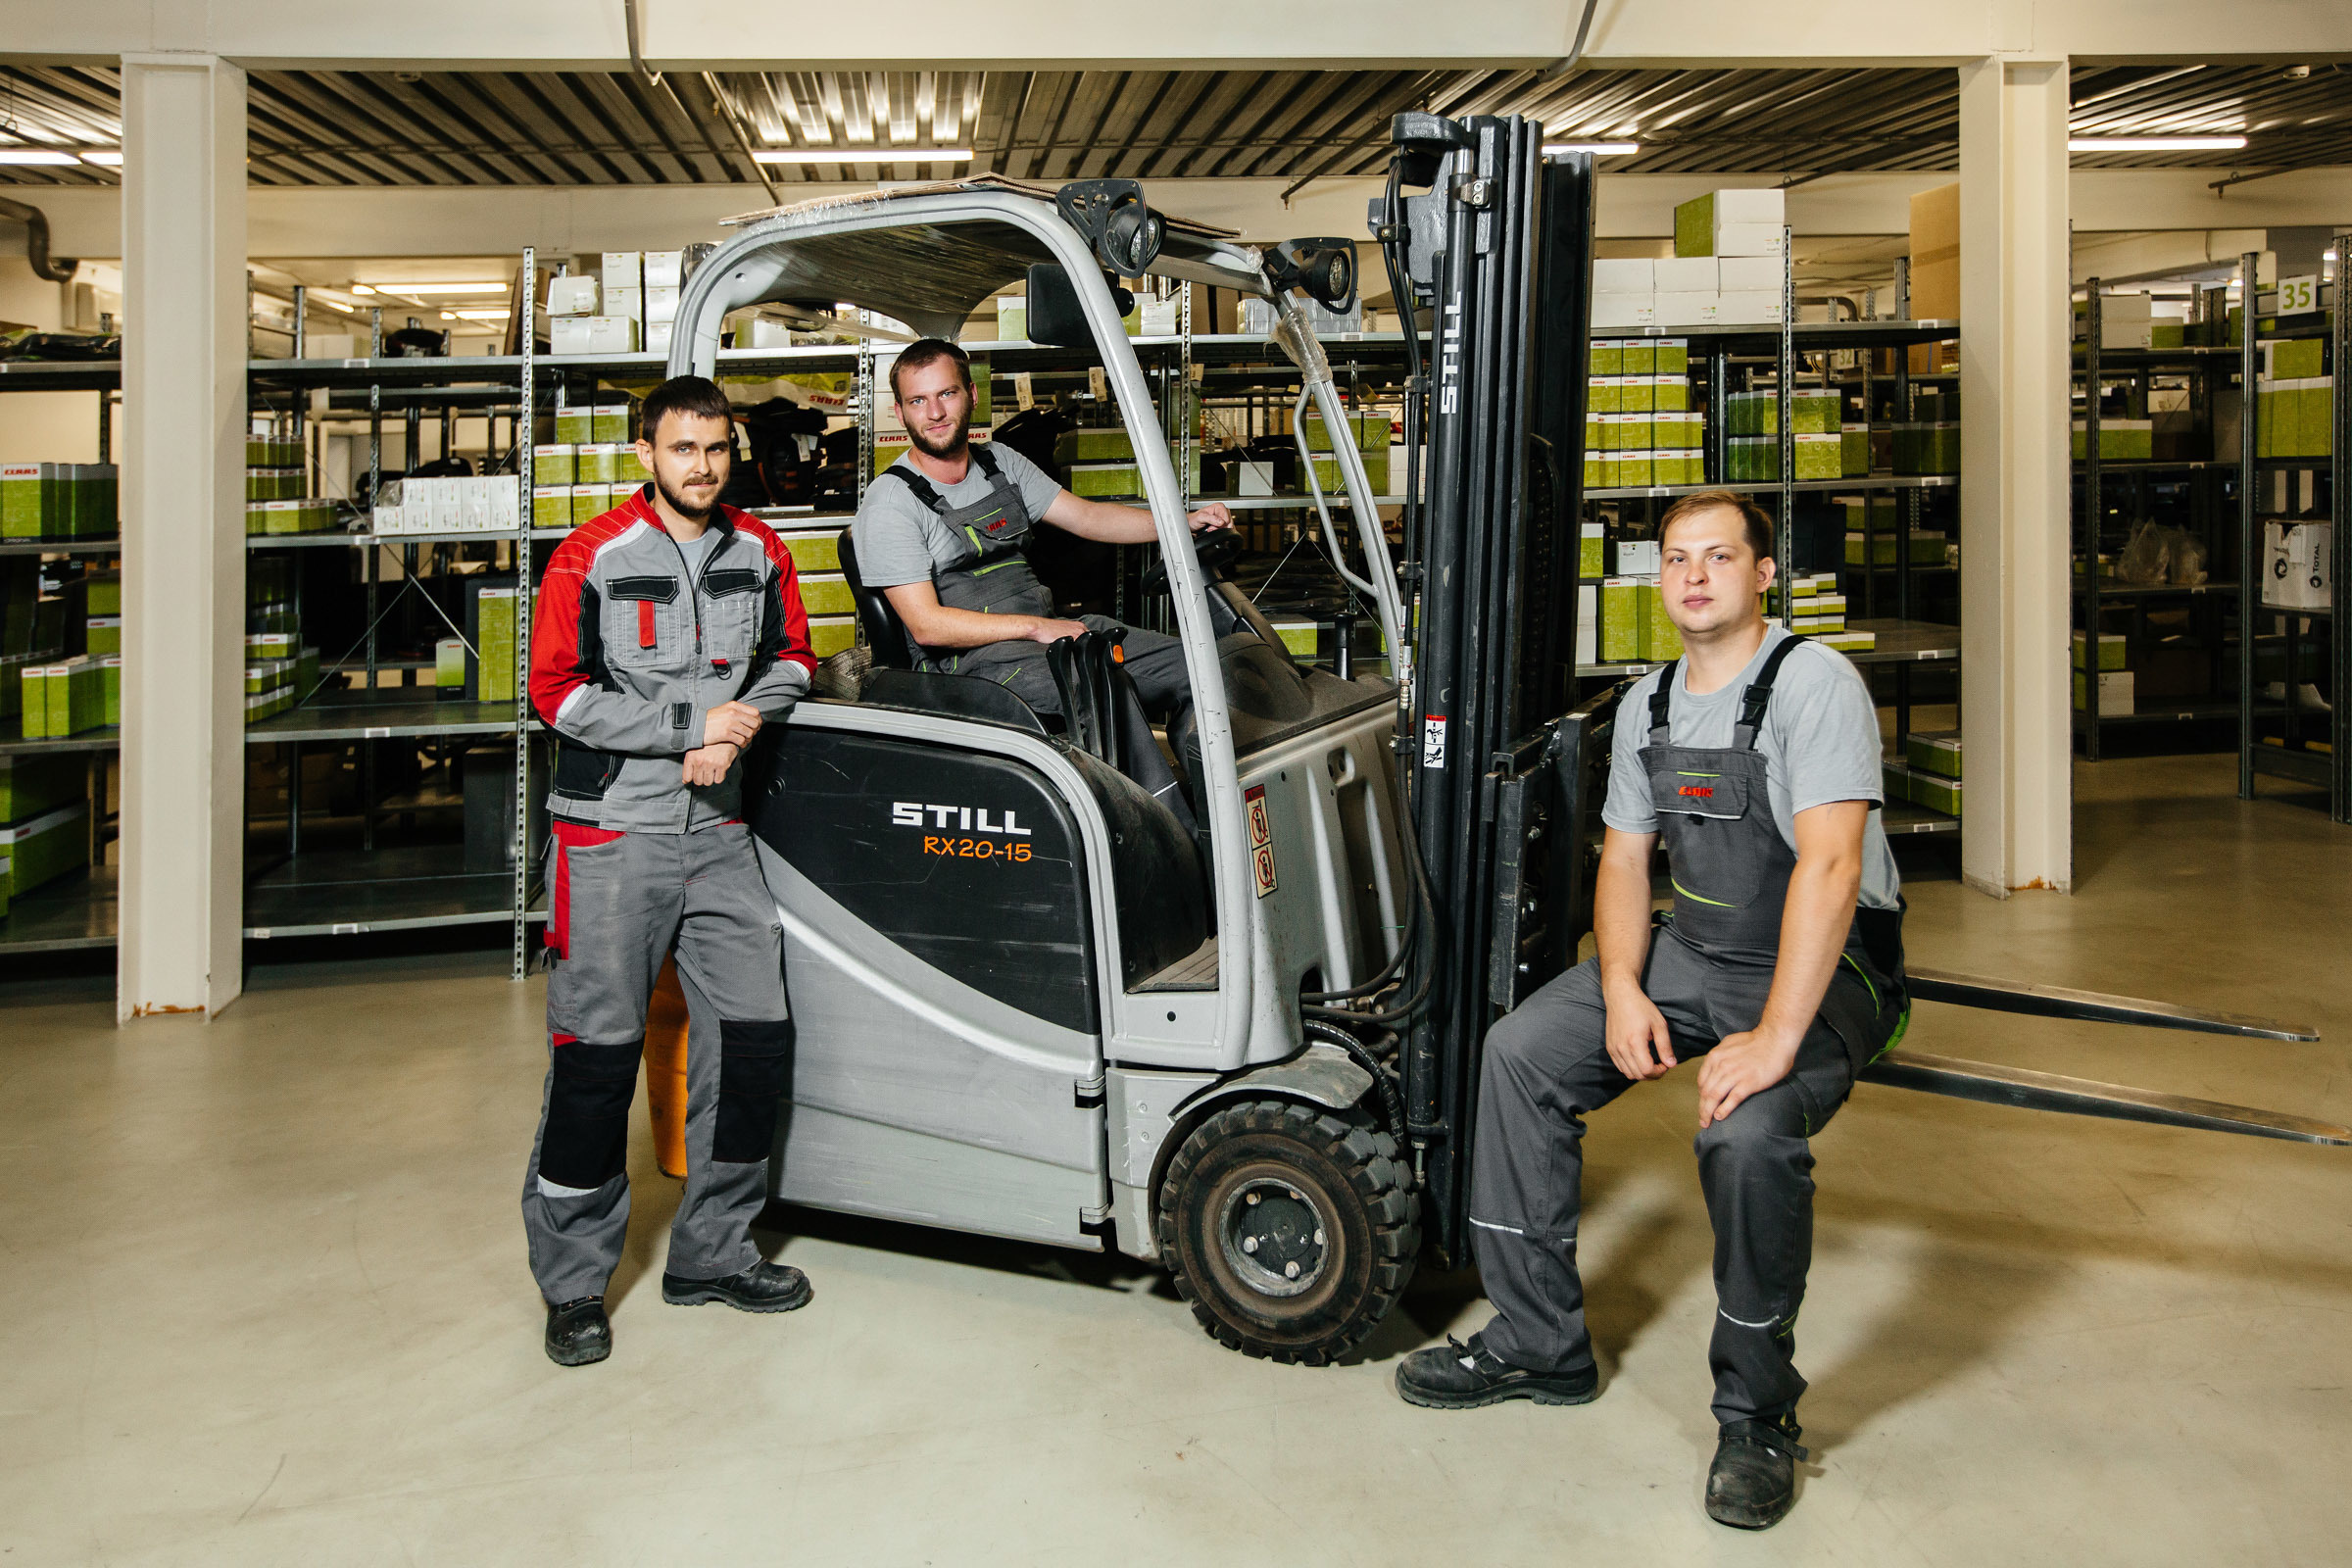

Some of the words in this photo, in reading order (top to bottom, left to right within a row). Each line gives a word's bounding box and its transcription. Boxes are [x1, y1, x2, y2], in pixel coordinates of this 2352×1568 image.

[2282, 282, 2311, 310] 35
[1441, 290, 1462, 415] STILL
[808, 394, 846, 407] CLAAS
[985, 517, 1007, 532] AAS
[892, 802, 1032, 836] STILL
